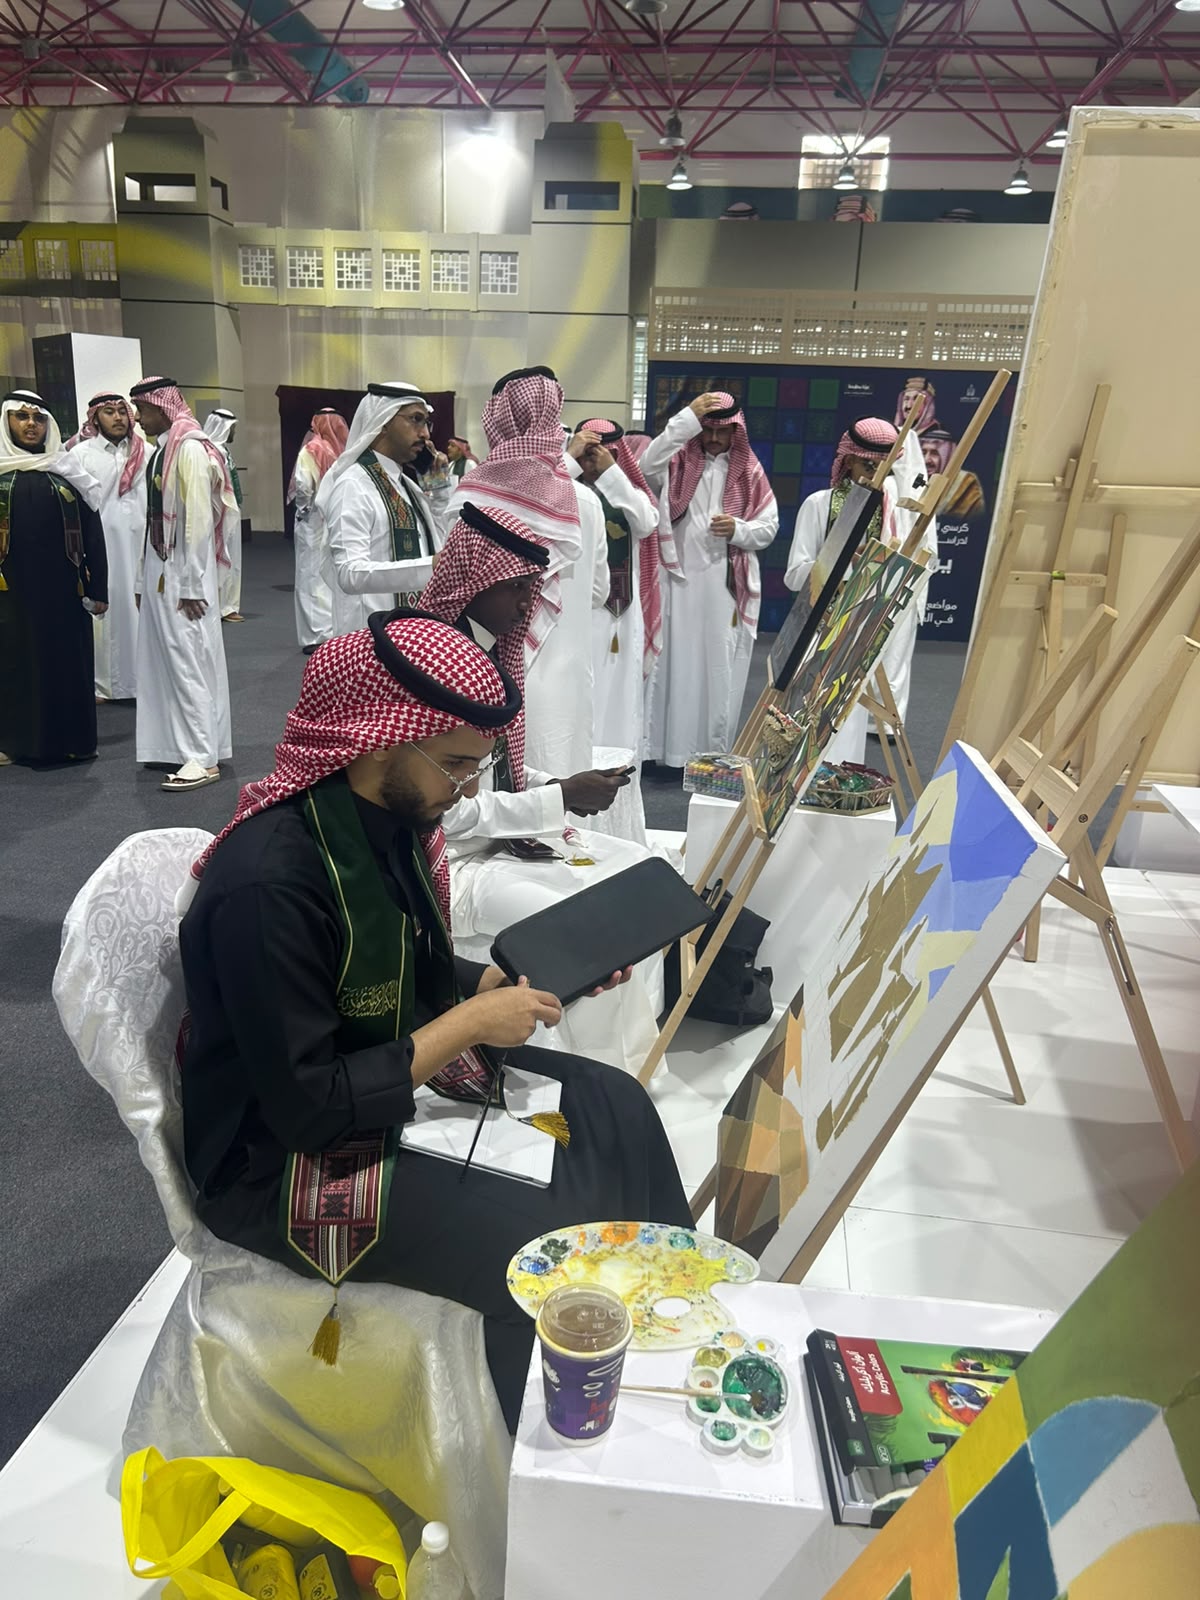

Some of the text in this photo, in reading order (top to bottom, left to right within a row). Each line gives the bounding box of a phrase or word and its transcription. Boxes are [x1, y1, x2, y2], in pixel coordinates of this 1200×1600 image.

[940, 523, 969, 534] كرسي
[926, 599, 957, 611] مواضع
[934, 614, 954, 628] في
[867, 1353, 891, 1395] Acrylic Colors
